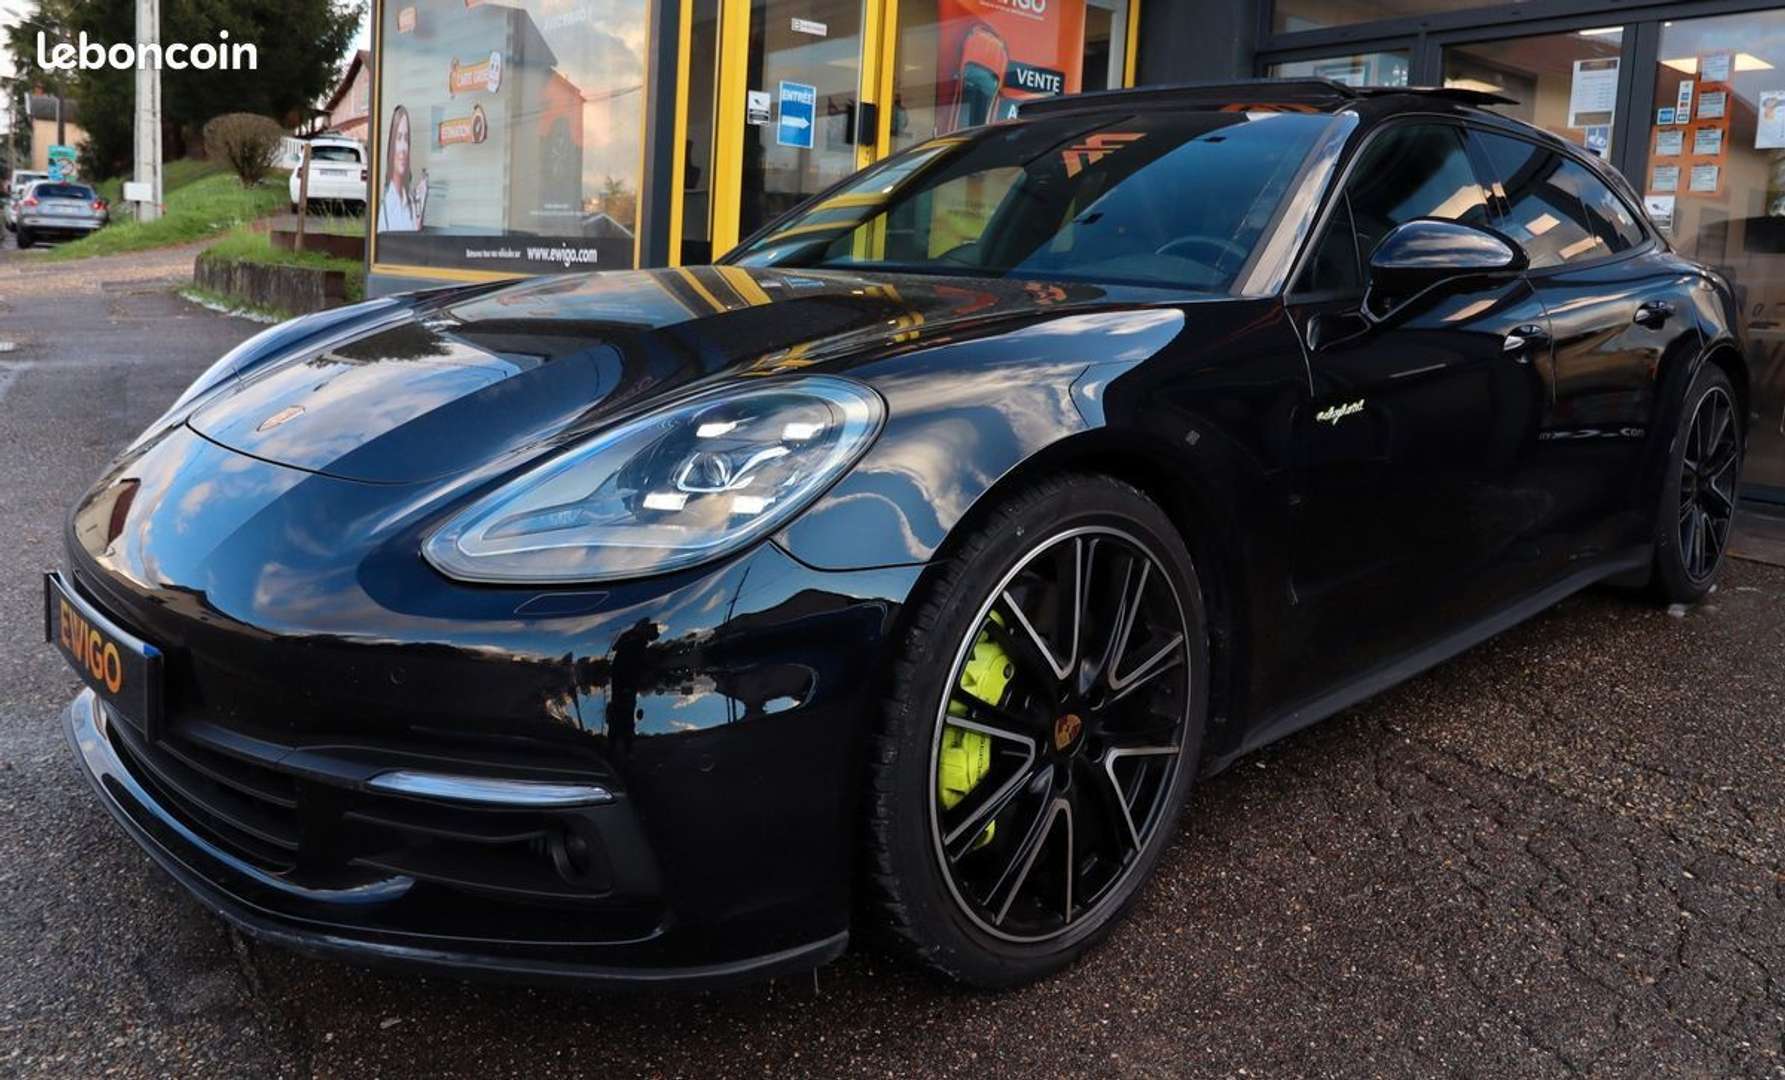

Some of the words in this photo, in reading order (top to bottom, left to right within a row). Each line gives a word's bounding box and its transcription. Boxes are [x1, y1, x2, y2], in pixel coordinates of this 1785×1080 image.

[1016, 67, 1061, 92] VENTE
[1007, 104, 1018, 119] A
[526, 242, 598, 267] www.ewigo.com
